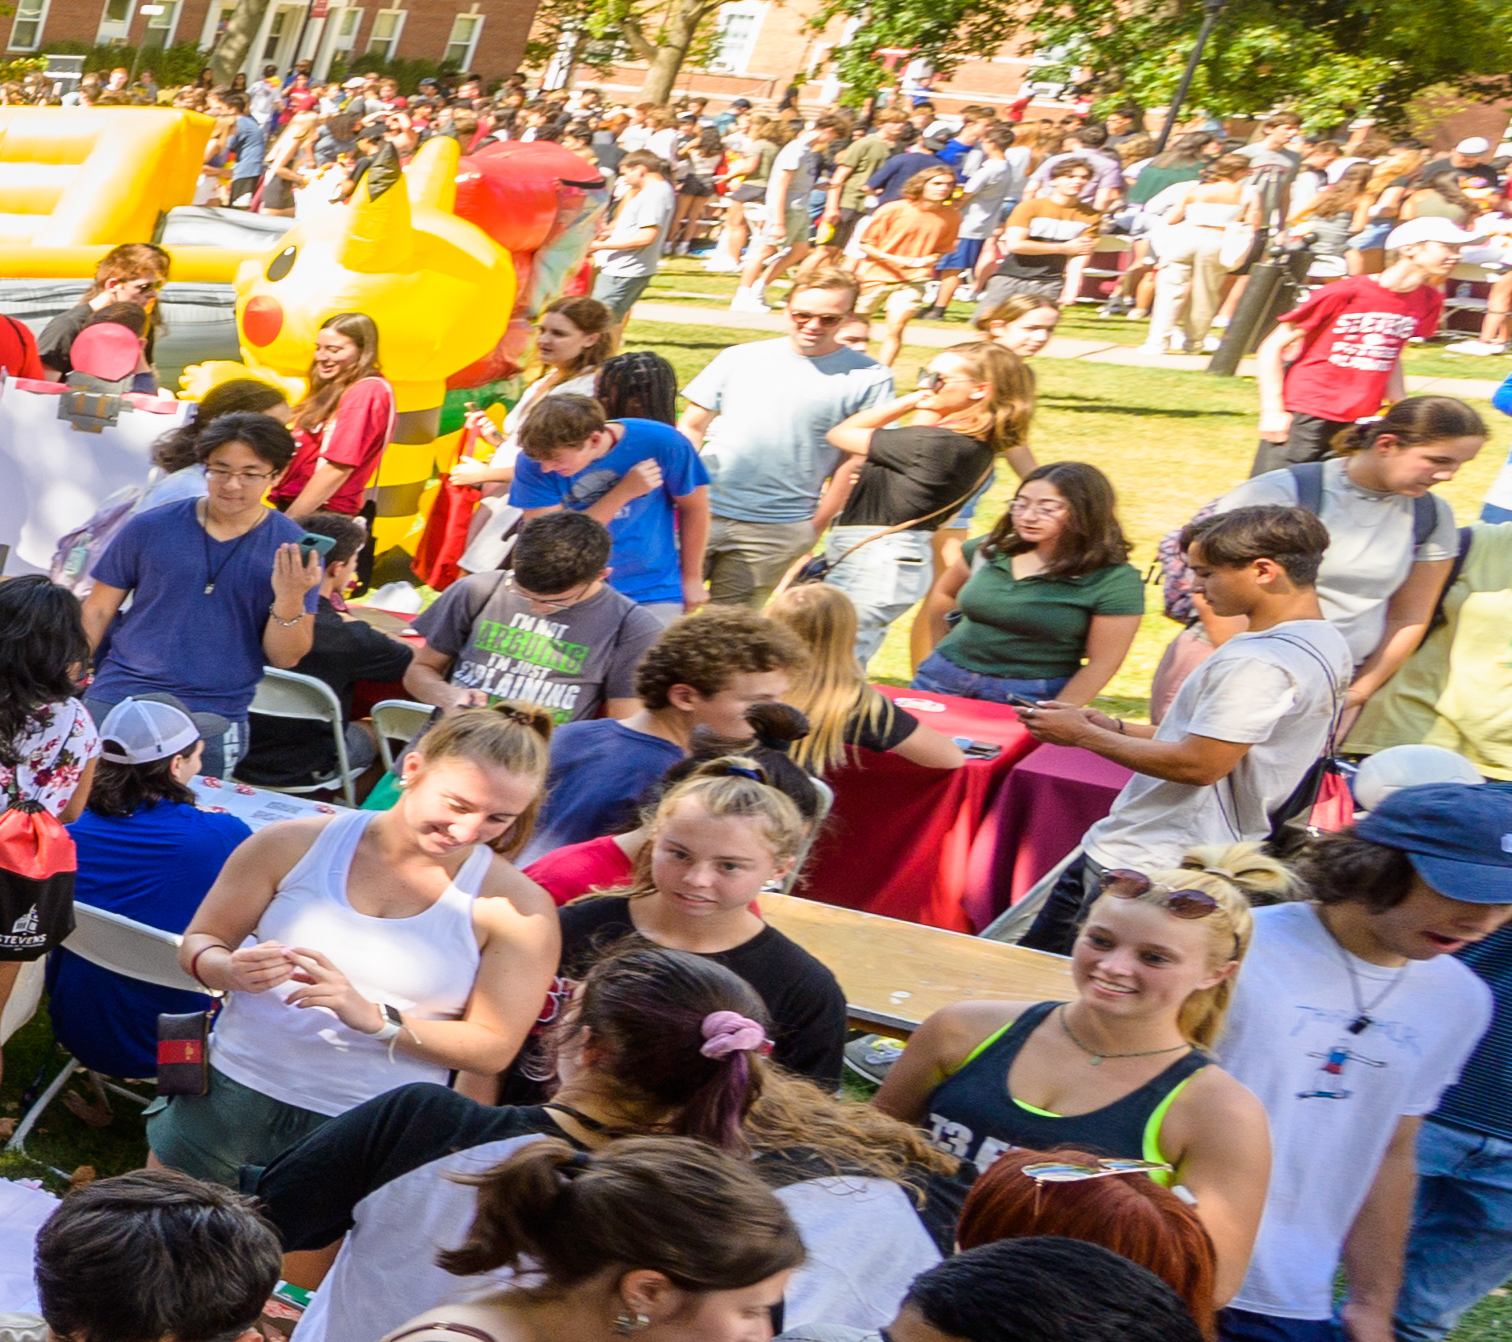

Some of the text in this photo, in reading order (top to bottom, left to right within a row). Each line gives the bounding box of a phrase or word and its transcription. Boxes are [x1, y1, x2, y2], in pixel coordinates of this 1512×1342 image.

[533, 618, 570, 640] NOT
[477, 622, 585, 672] ARGUING
[510, 660, 552, 681] JUST
